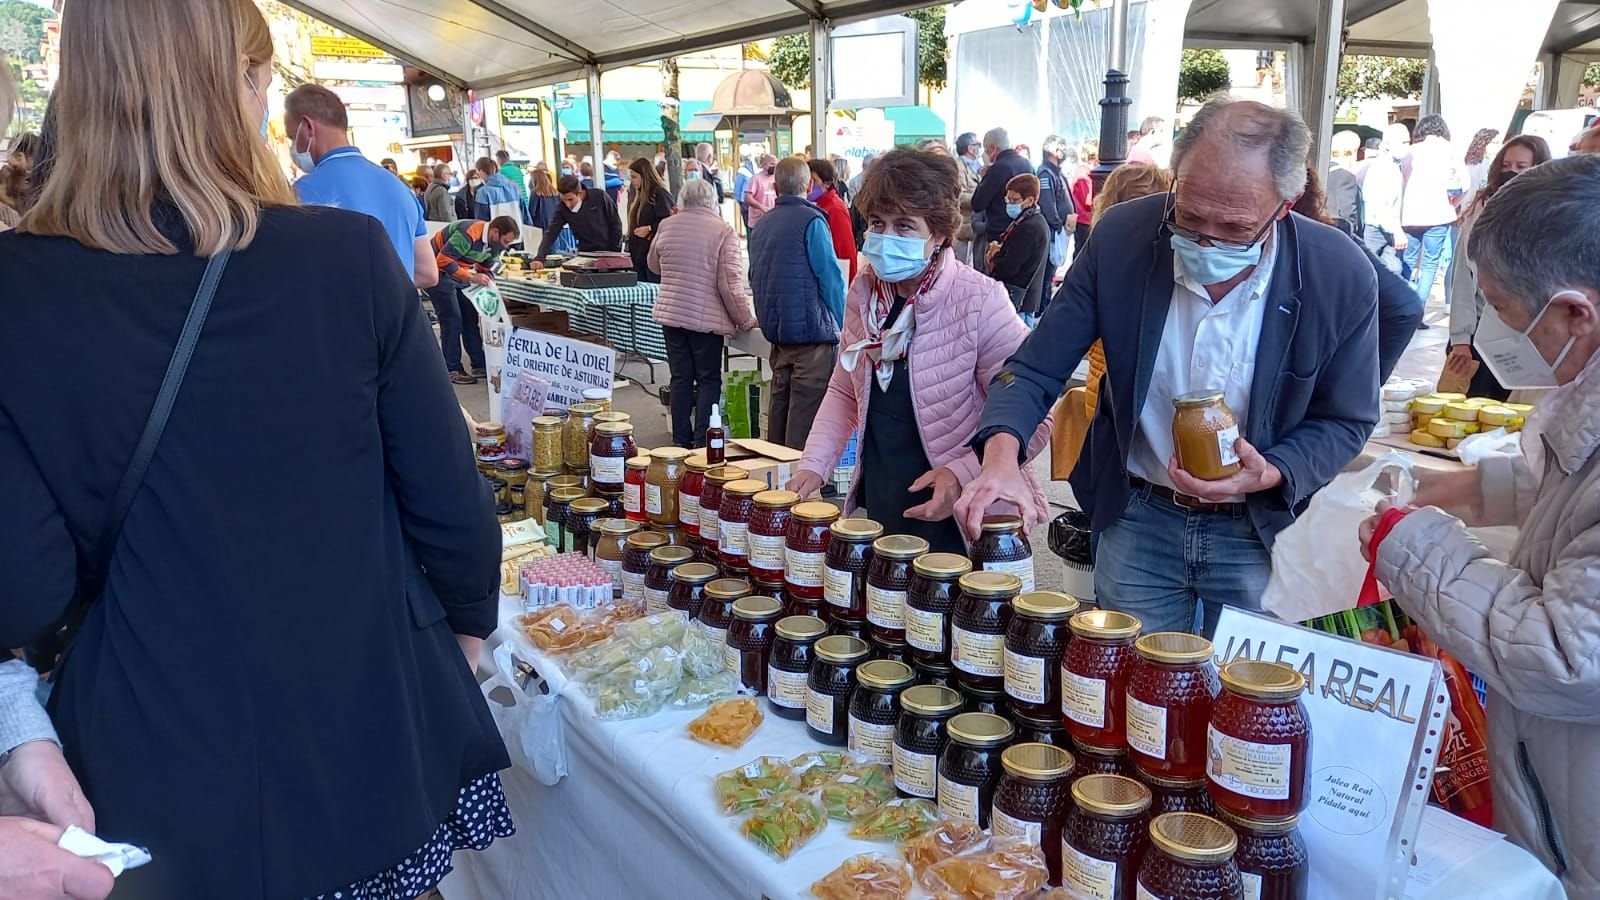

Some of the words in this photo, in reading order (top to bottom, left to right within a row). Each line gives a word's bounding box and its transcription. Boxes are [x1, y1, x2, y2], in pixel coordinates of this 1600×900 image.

[506, 352, 521, 367] DEL
[523, 358, 560, 375] ORIENTE
[561, 364, 572, 379] DE
[574, 370, 610, 389] ASTURIAS
[507, 336, 542, 357] FERIA
[545, 342, 562, 359] DE
[566, 345, 579, 364] LA
[582, 353, 611, 374] MIEL
[1323, 658, 1416, 724] REAL
[1325, 775, 1350, 789] Jalea
[1351, 783, 1374, 796] Real
[1328, 787, 1365, 805] Natural
